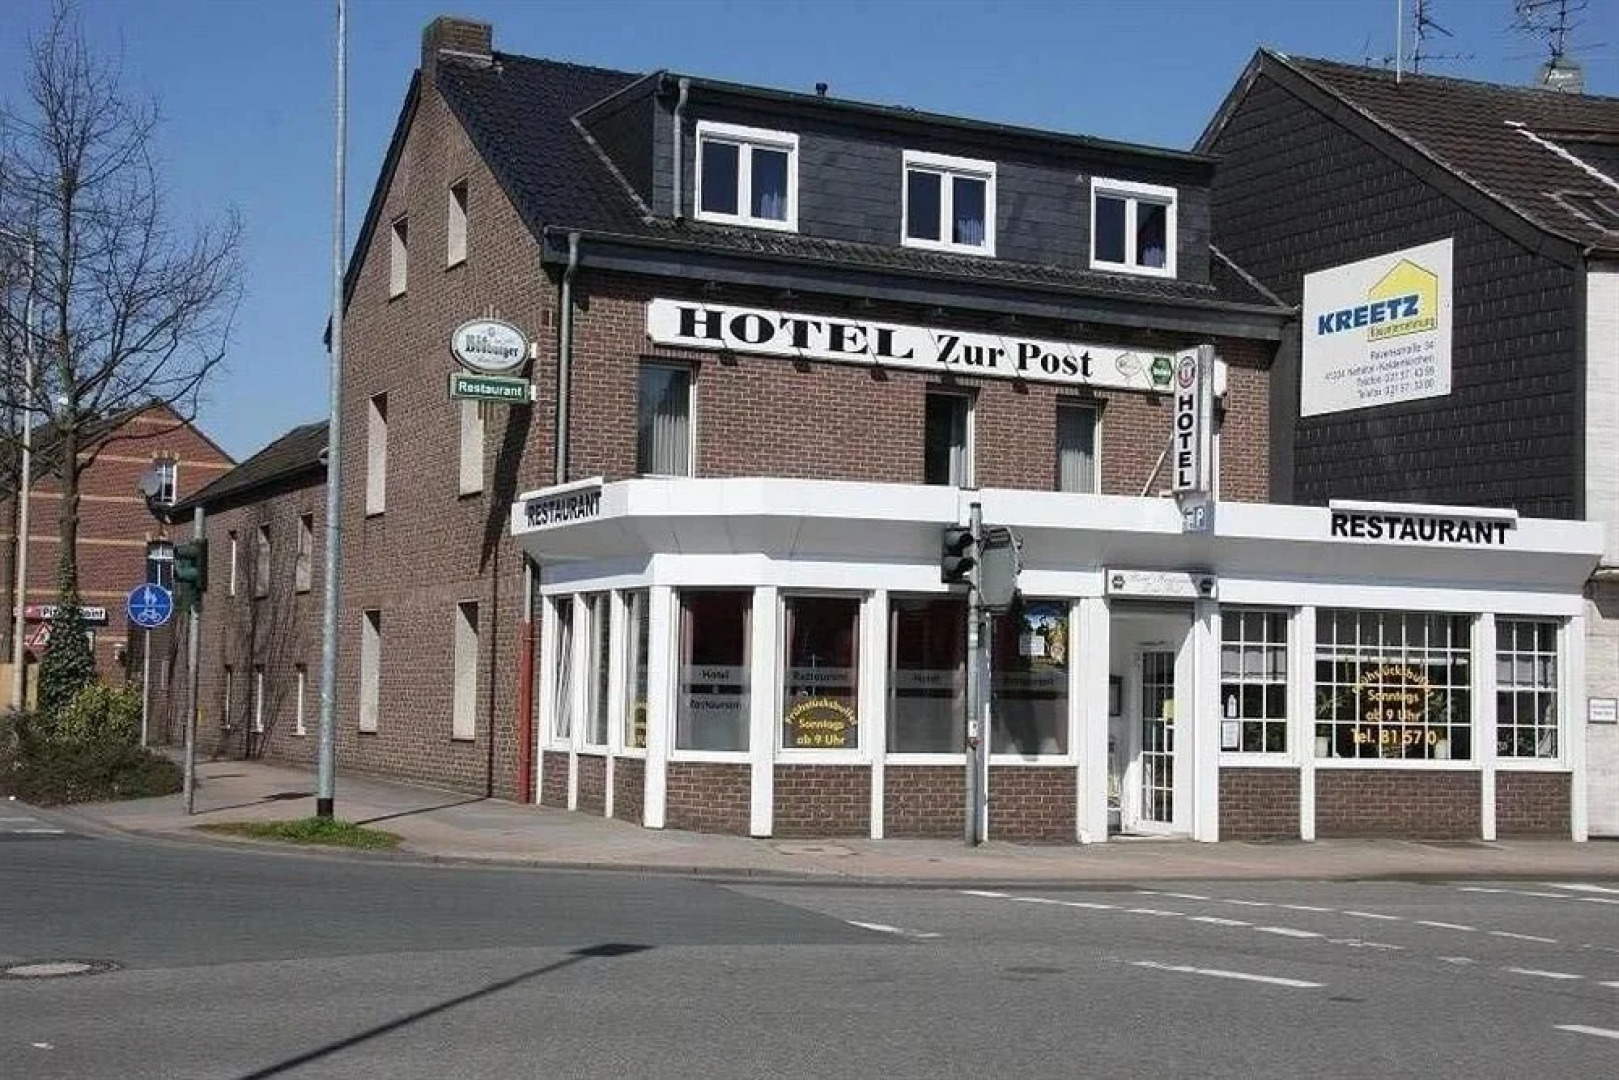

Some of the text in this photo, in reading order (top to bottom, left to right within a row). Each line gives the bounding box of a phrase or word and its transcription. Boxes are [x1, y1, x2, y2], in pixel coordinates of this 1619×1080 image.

[1318, 294, 1419, 335] KREETZ
[676, 306, 1094, 378] HOTEL Zur Post
[459, 381, 522, 397] Restaurant
[1177, 394, 1194, 487] HOTEL
[527, 491, 602, 528] RESTAURANT
[1331, 513, 1511, 545] RESTAURANT
[1386, 708, 1394, 720] 9
